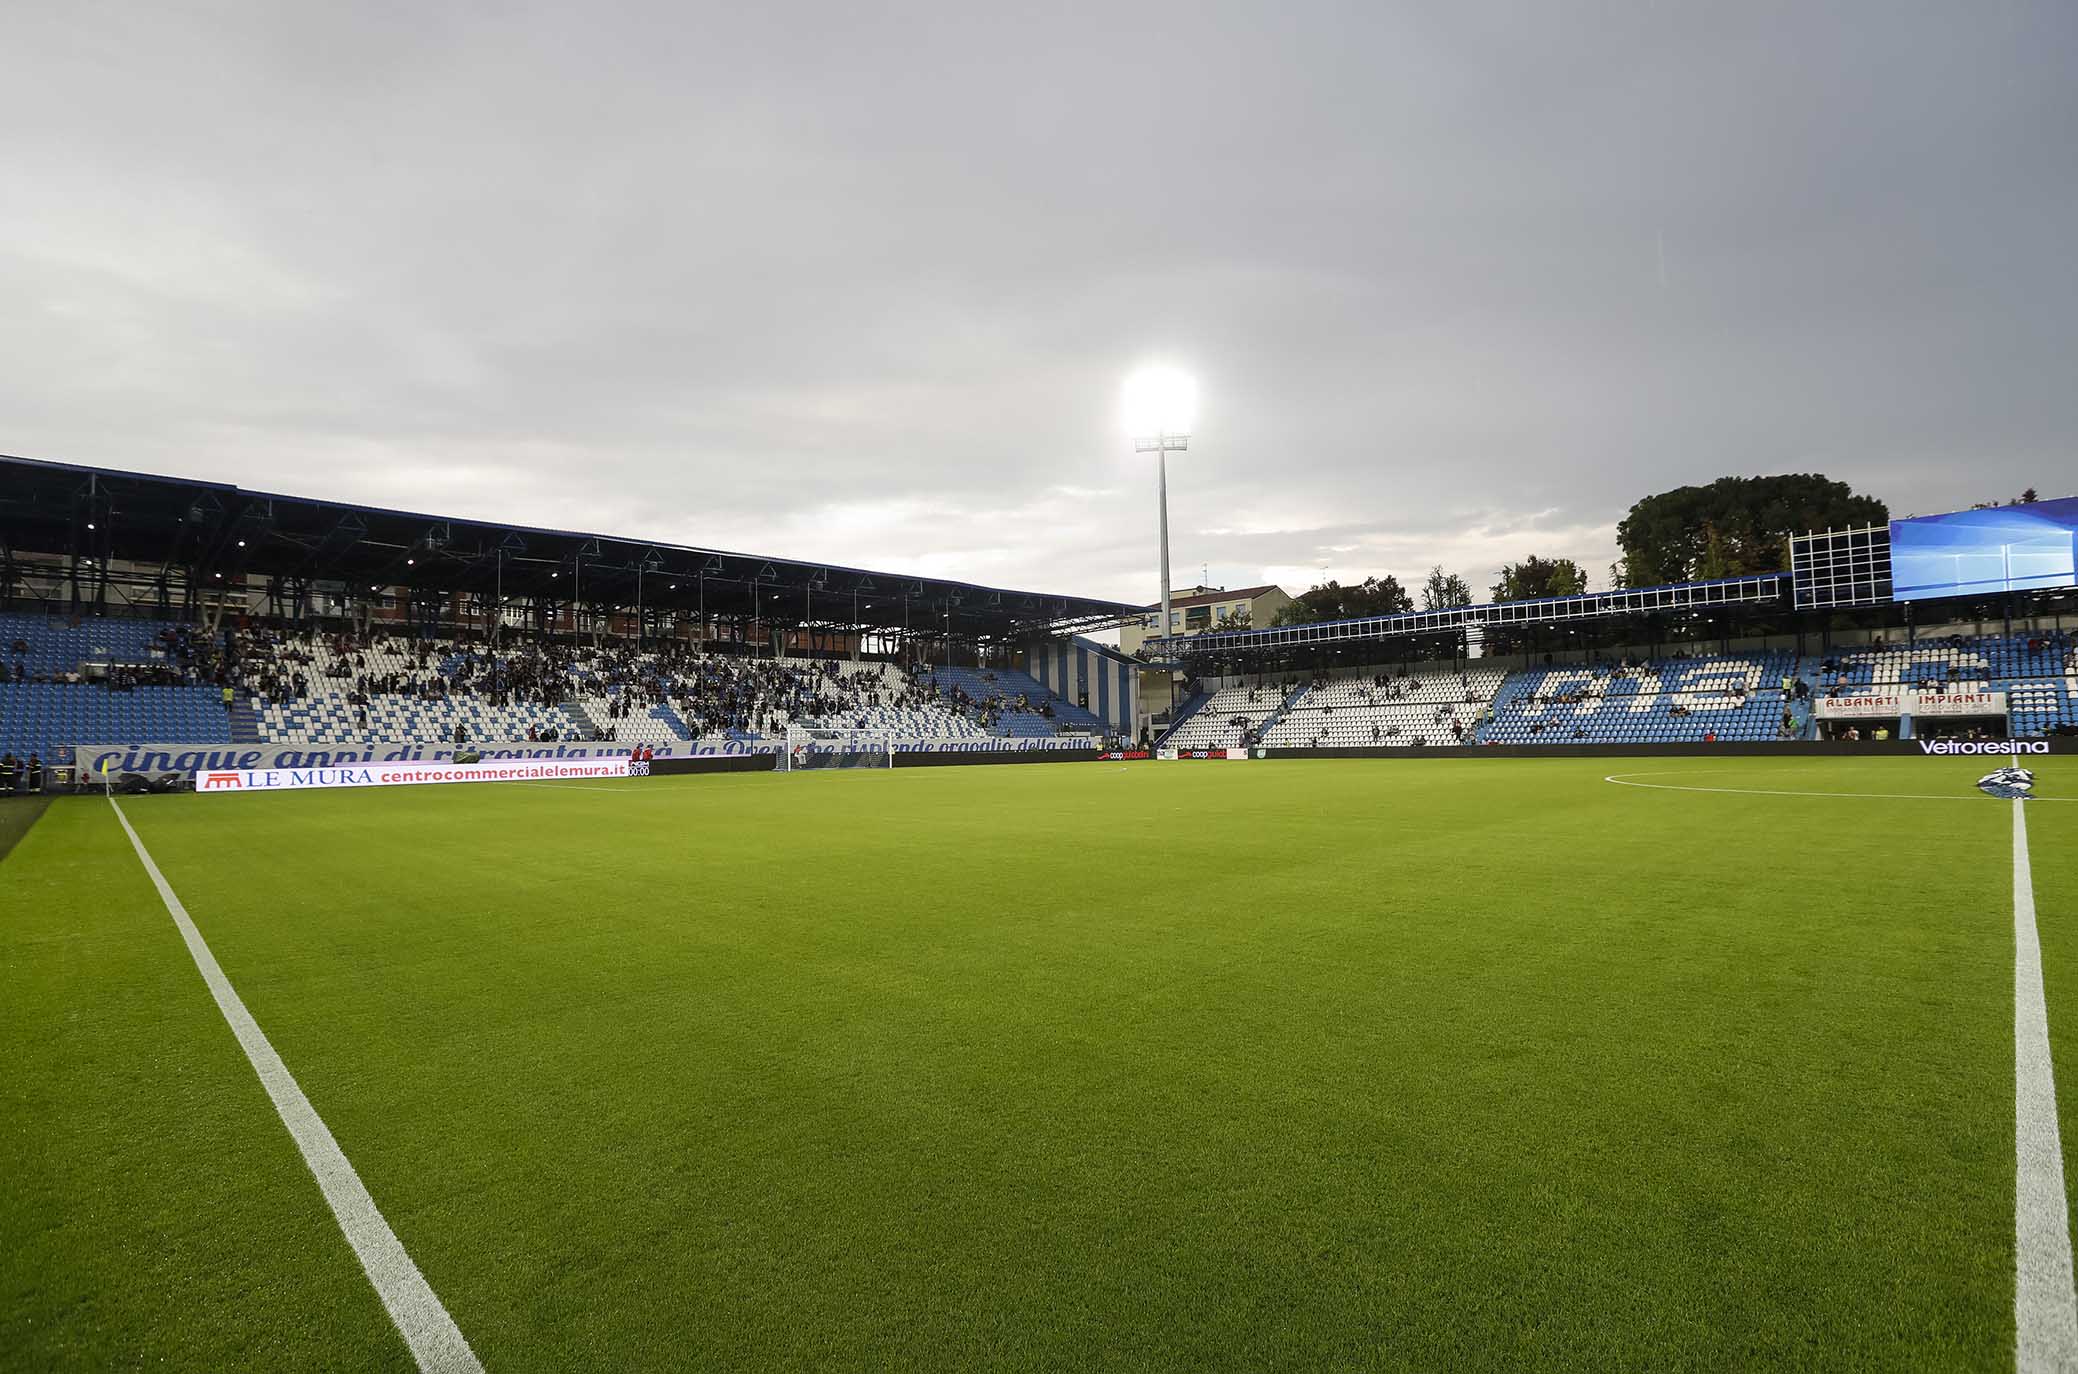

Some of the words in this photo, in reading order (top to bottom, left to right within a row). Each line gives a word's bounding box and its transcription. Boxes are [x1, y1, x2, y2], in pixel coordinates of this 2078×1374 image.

[1919, 694, 1992, 704] IMPIANTI
[1919, 739, 2049, 755] Vetroresina
[94, 745, 262, 779] cinque
[247, 772, 281, 787] LE
[290, 769, 374, 786] MURA
[381, 764, 625, 783] centrocommercialelemura.it
